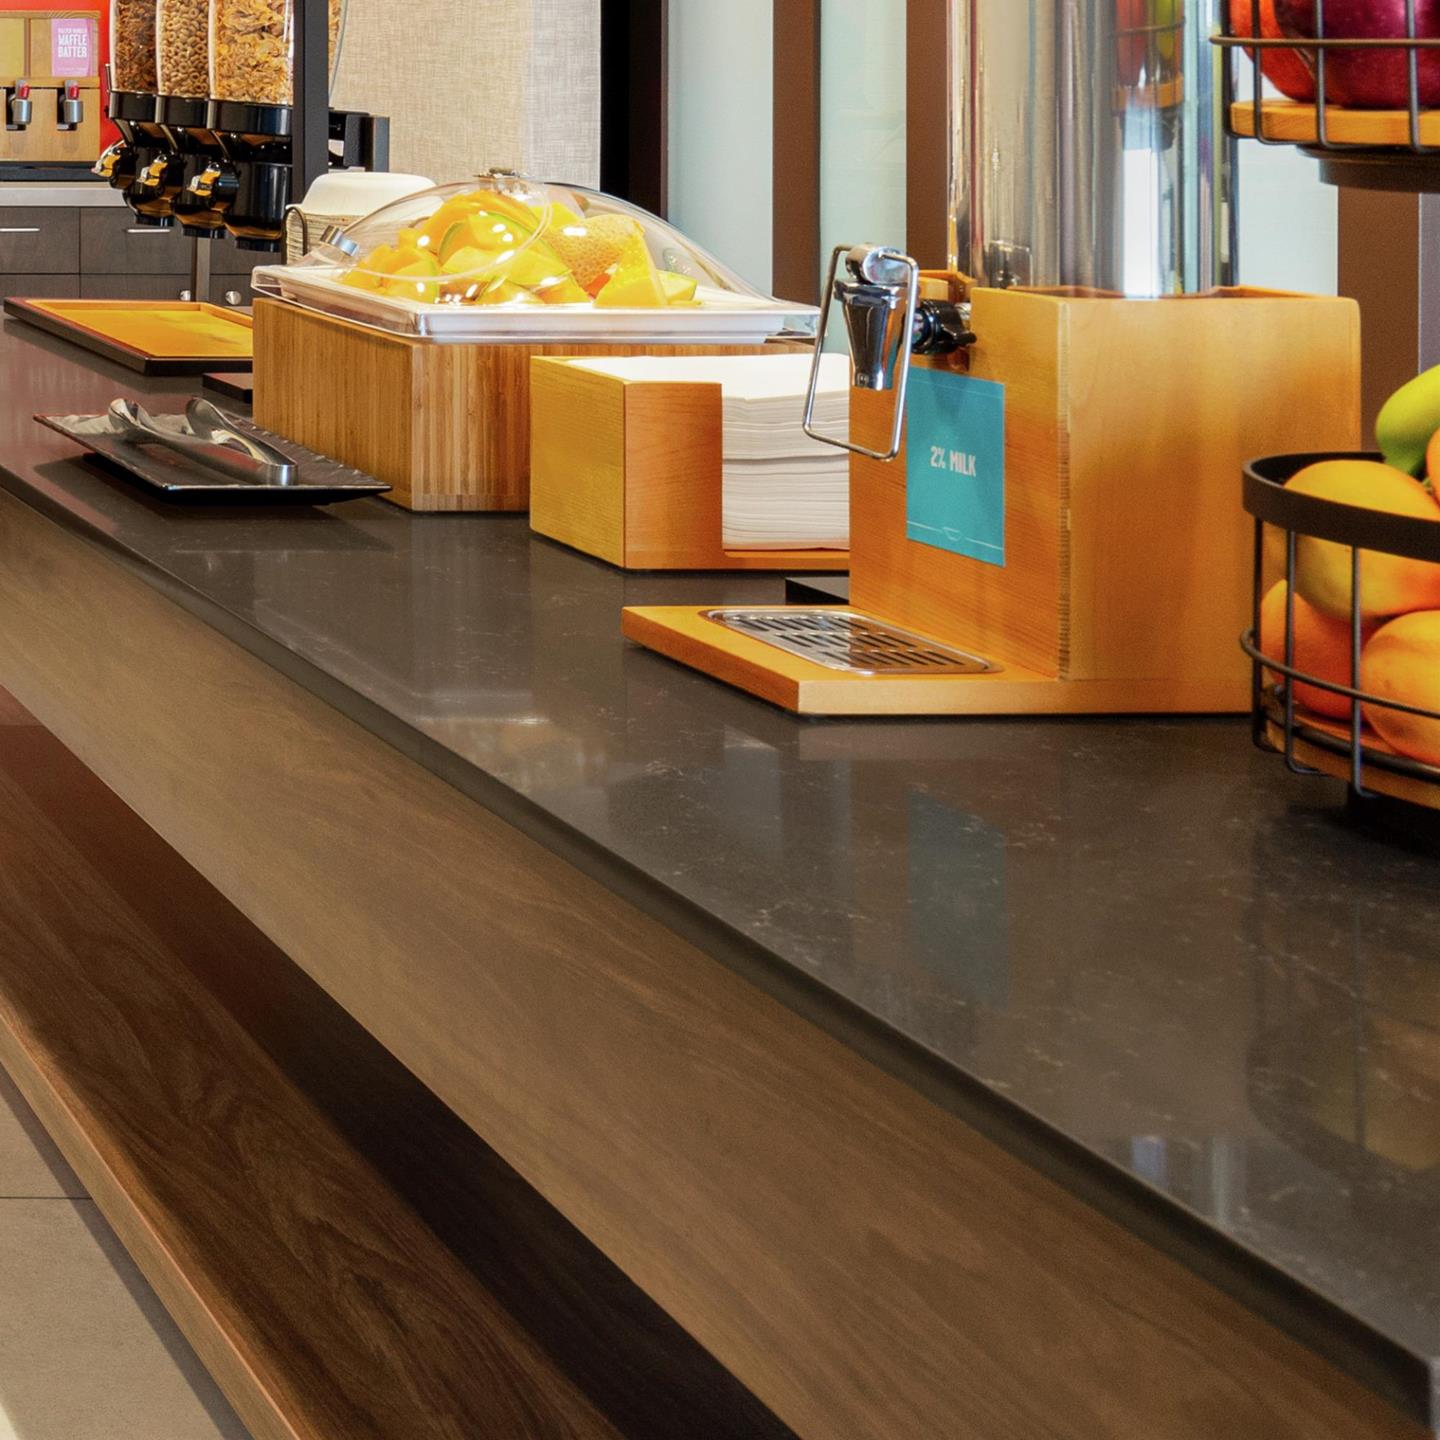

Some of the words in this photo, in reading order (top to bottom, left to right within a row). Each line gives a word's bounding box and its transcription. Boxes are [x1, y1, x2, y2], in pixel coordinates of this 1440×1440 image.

[58, 34, 88, 46] WAFFLE
[58, 46, 88, 58] BATTER
[930, 446, 946, 469] 2%
[949, 449, 977, 478] MILK
